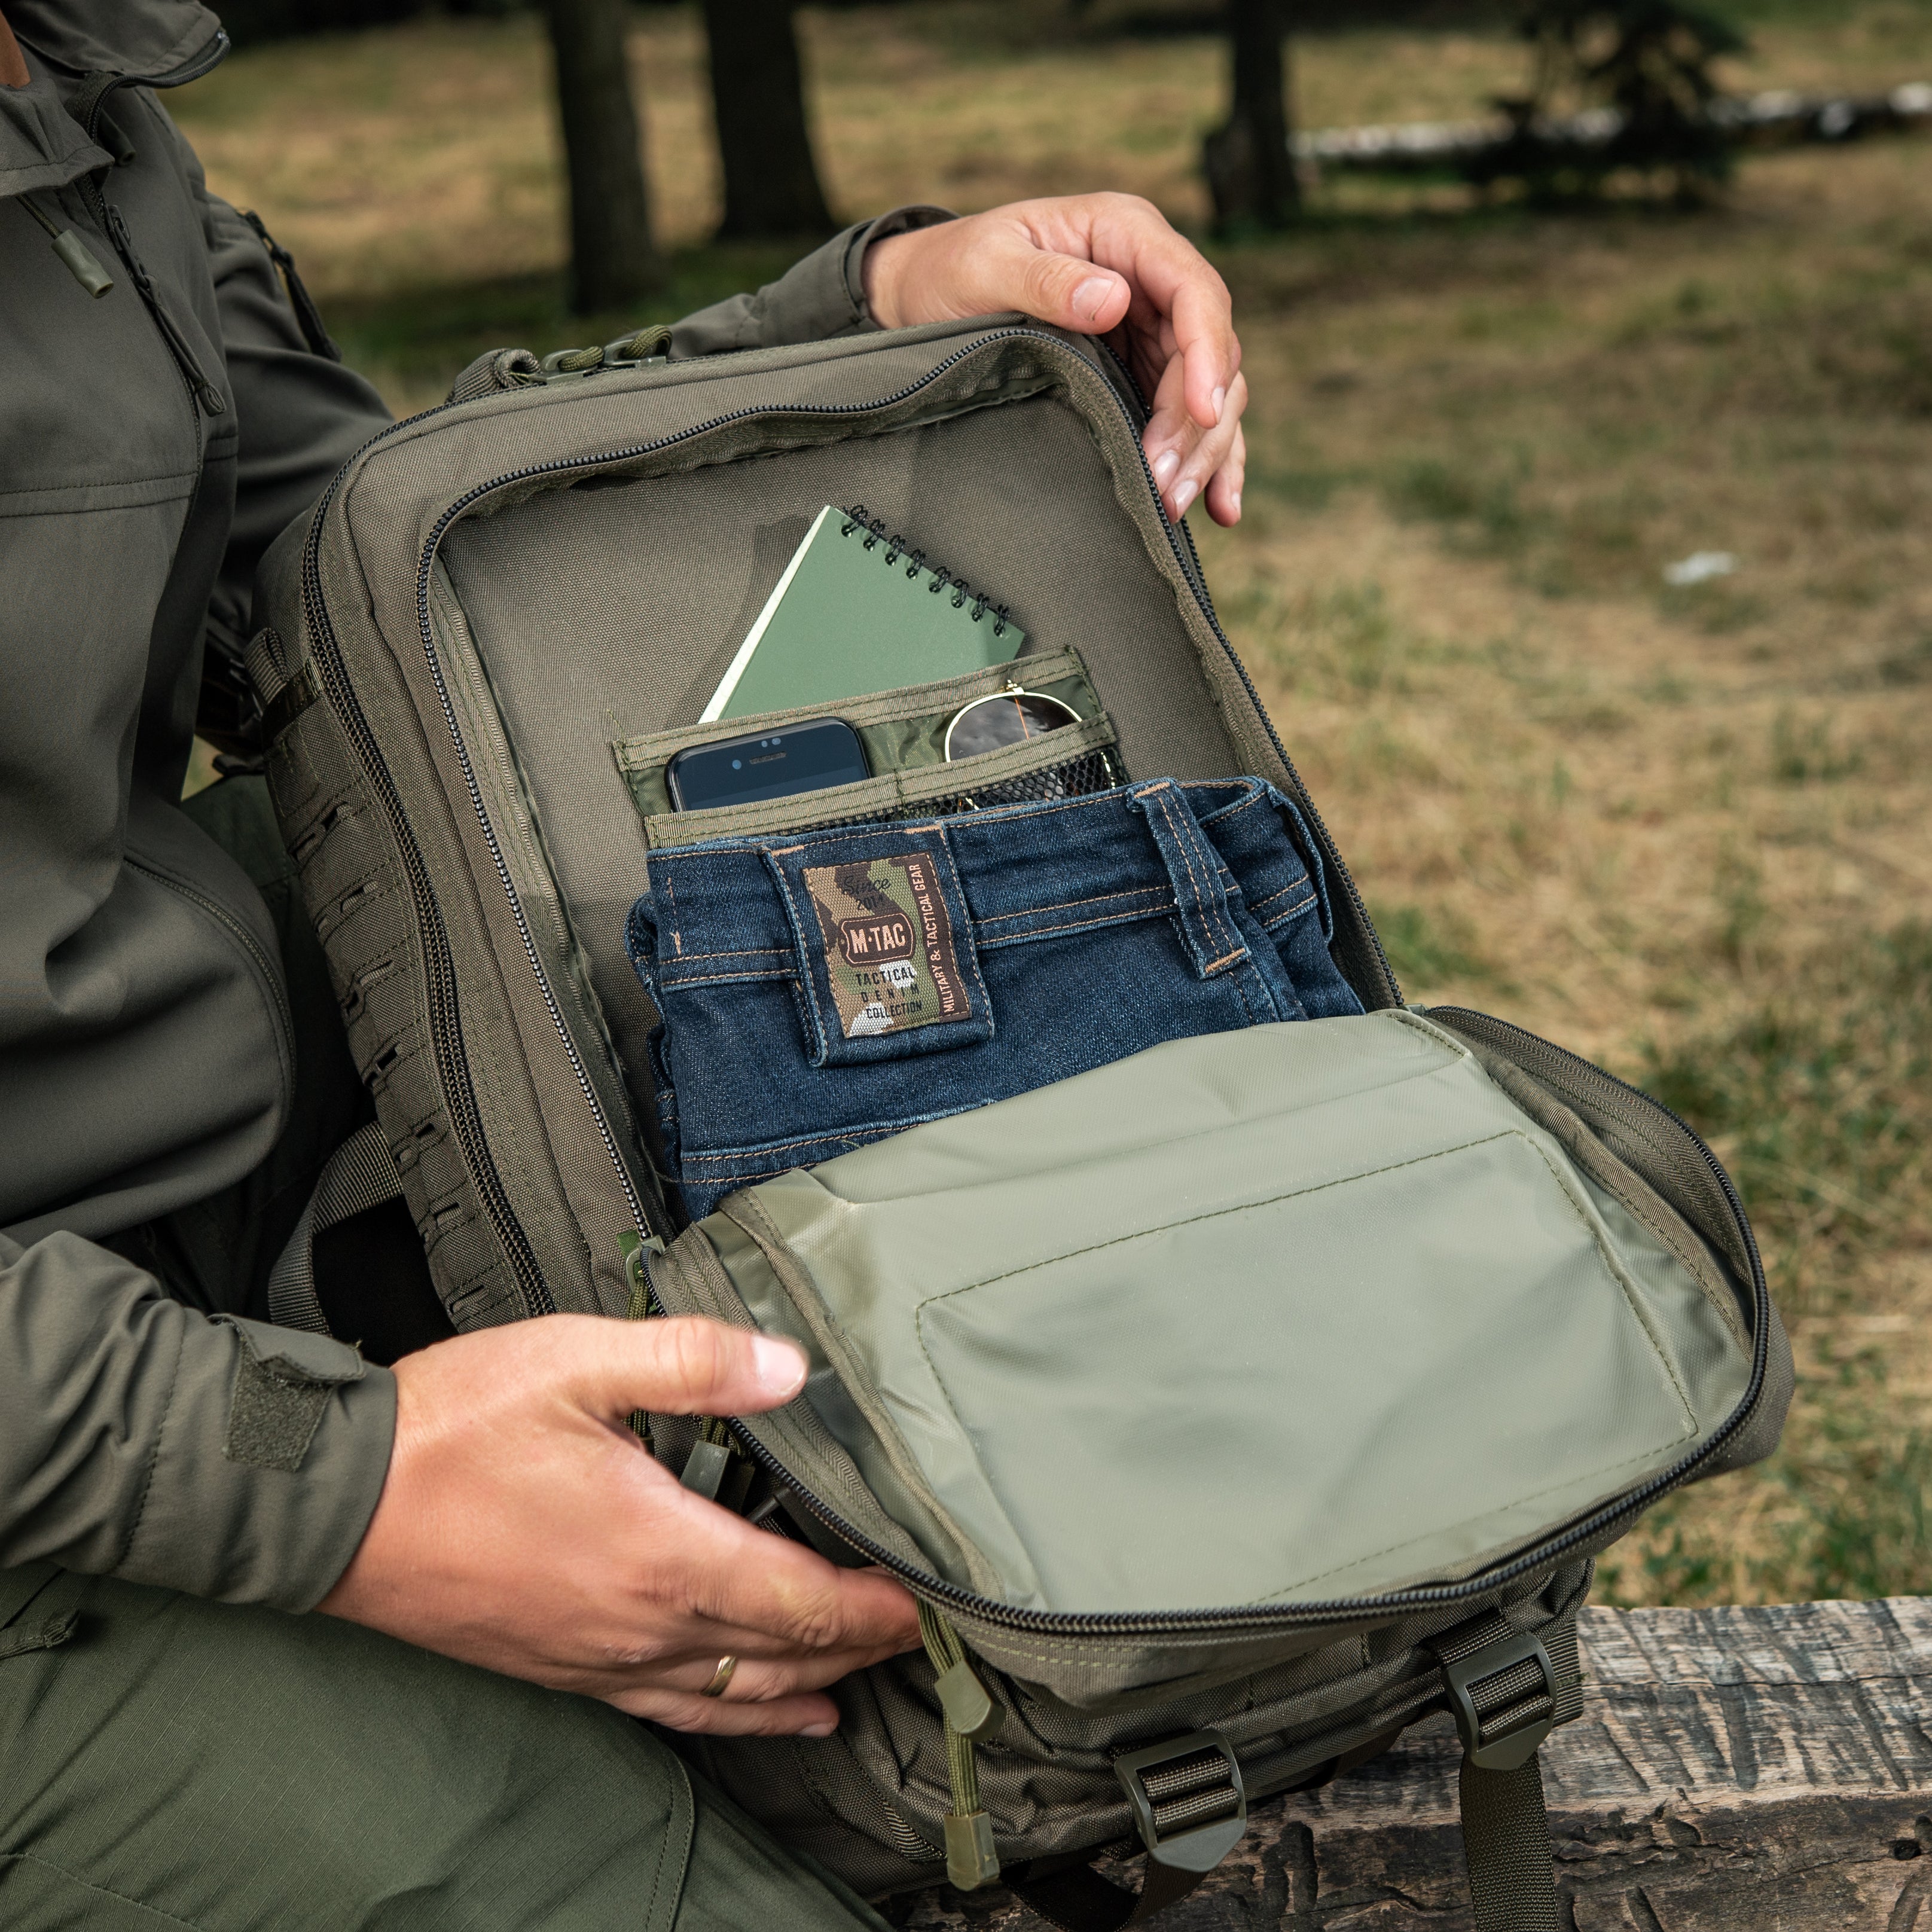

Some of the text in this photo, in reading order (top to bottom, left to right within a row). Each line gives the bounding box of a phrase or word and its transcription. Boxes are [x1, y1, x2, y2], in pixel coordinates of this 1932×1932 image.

[909, 864, 955, 1013] MILITARY & TACTICAL GEAR
[856, 967, 915, 986] TACTICAL
[866, 1000, 922, 1018] COLLECTION
